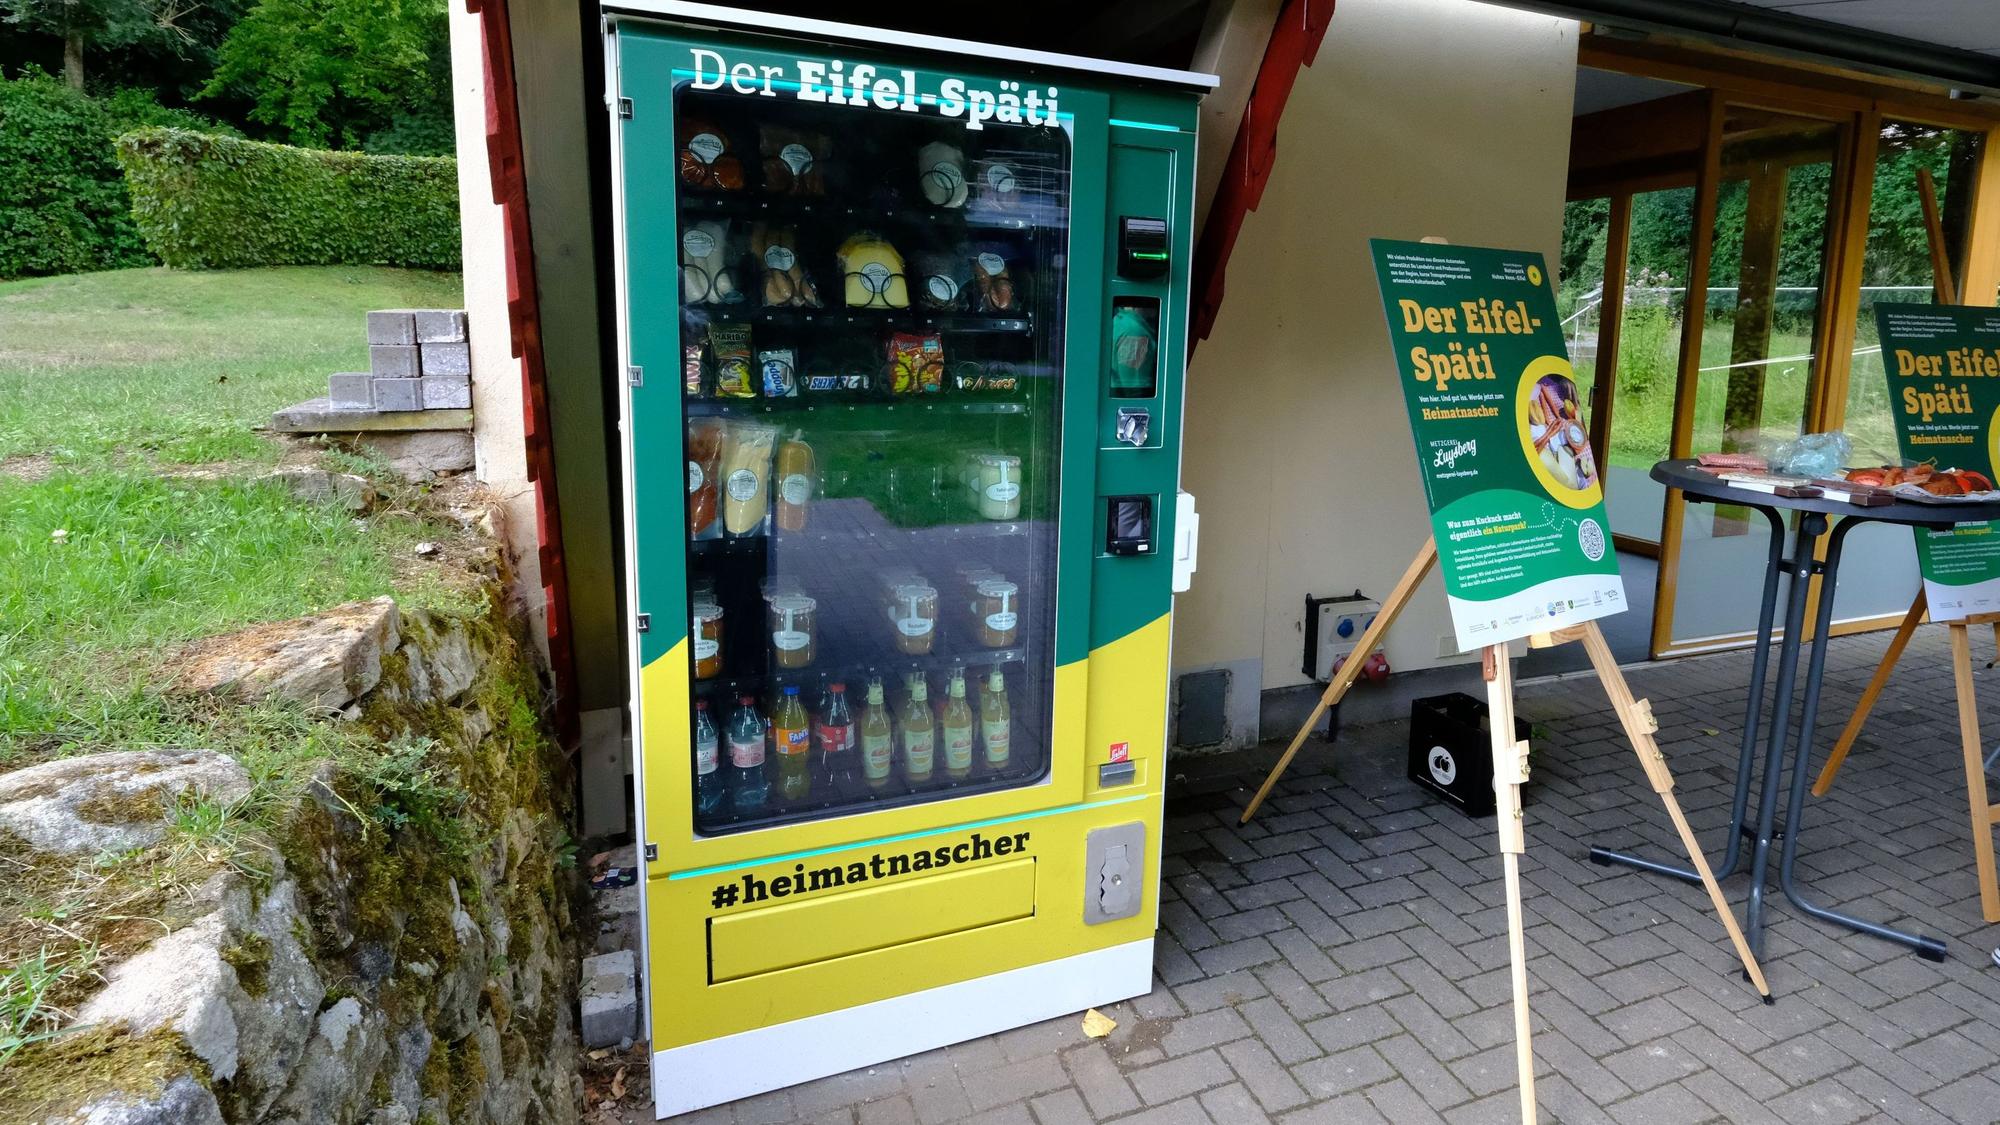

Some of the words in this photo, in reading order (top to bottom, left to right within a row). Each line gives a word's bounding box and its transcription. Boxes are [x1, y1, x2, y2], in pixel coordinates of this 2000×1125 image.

[689, 48, 783, 97] Der
[796, 60, 1060, 131] Eifel-Späti
[1398, 299, 1457, 334] Der
[1460, 297, 1542, 335] Eifel-
[714, 332, 747, 341] HARIBO
[1410, 341, 1497, 391] Späti
[1895, 349, 1943, 376] Der
[1422, 404, 1500, 421] Heimatnascher
[1902, 383, 1974, 422] Späti
[1909, 433, 1975, 445] Heimatnascher
[1433, 439, 1477, 469] Luysberg
[1446, 520, 1462, 529] Was
[1461, 519, 1476, 528] zum
[1475, 514, 1503, 526] Kuckuck
[1502, 511, 1522, 522] macht
[1449, 528, 1483, 542] eigentlich
[711, 831, 1031, 910] #heimatnascher
